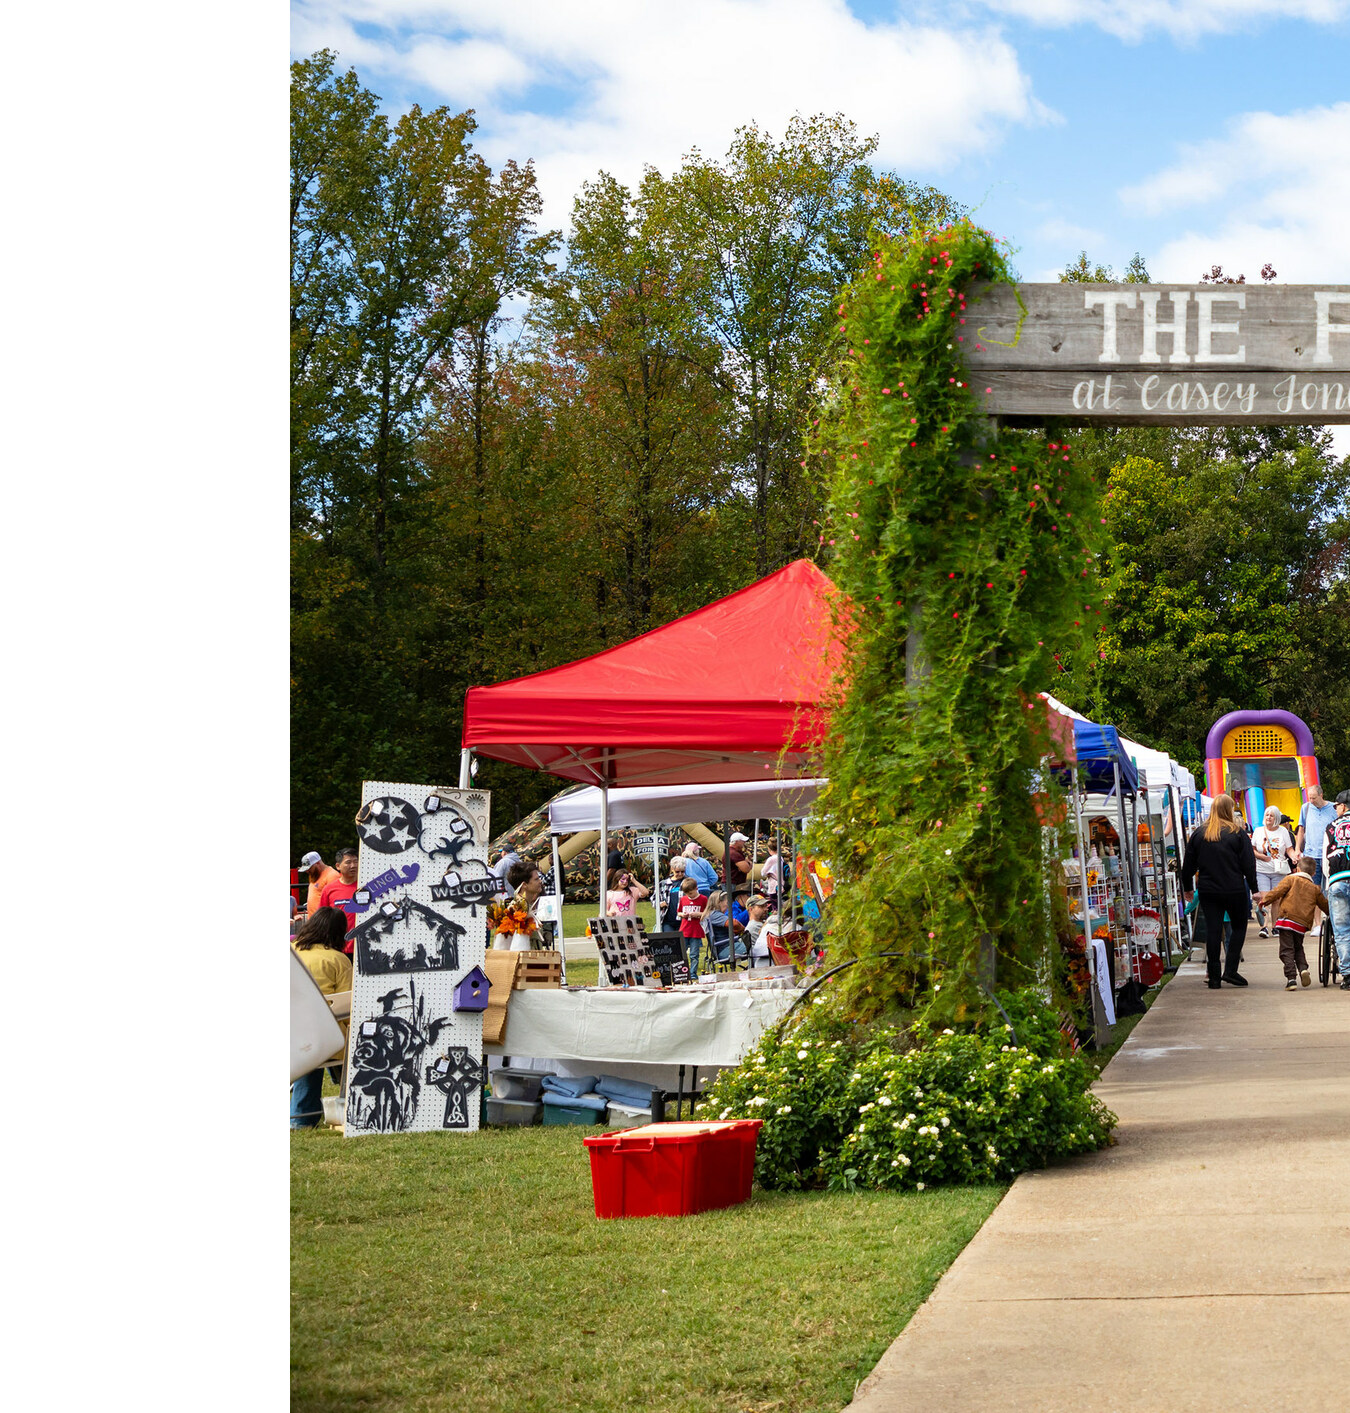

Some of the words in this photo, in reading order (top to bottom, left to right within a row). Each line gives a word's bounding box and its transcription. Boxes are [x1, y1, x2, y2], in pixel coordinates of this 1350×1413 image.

[1084, 291, 1246, 364] THE
[1071, 374, 1128, 410] at
[1133, 374, 1259, 413] Casey
[432, 879, 504, 898] WELCOME
